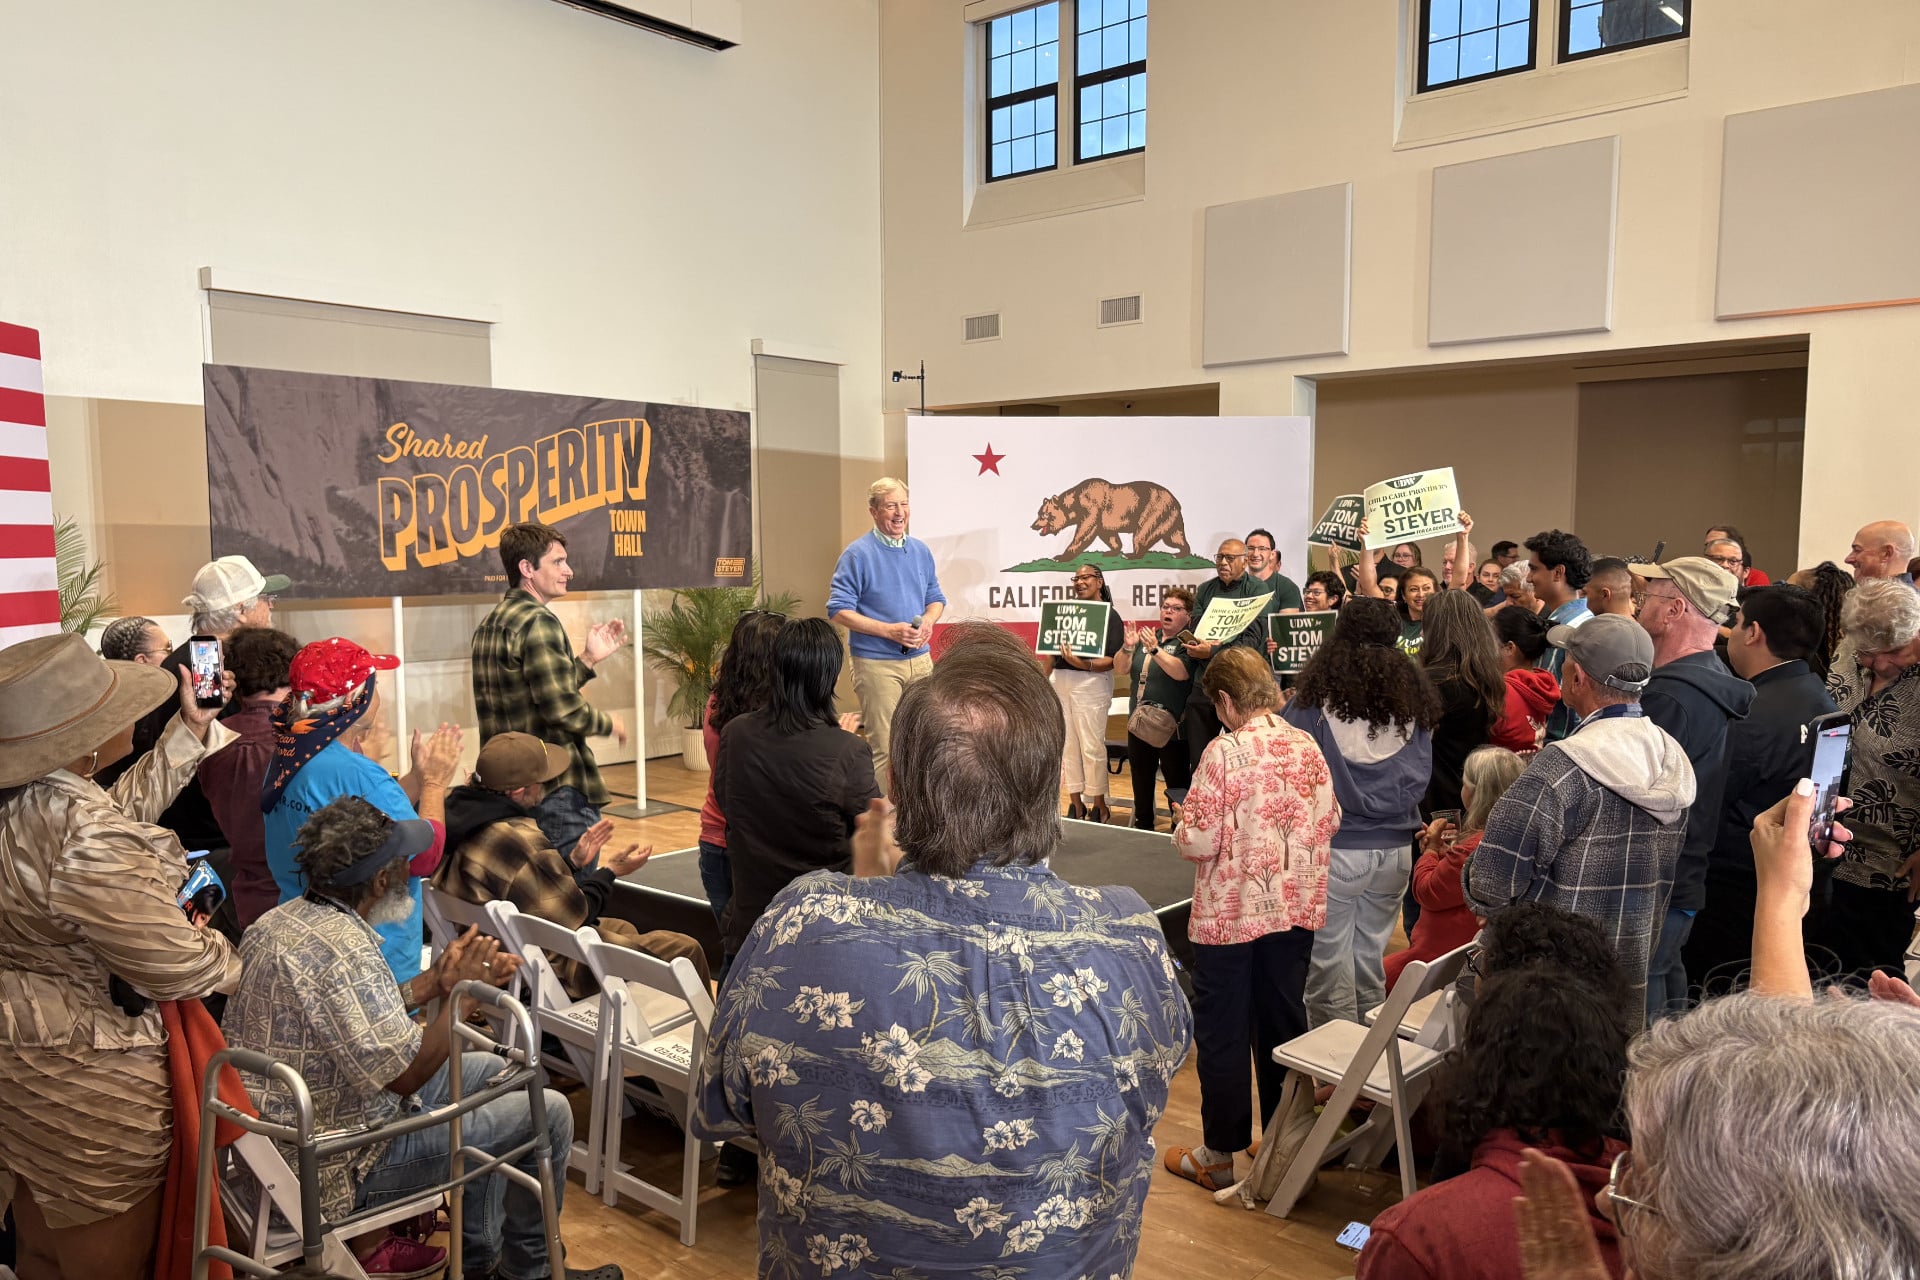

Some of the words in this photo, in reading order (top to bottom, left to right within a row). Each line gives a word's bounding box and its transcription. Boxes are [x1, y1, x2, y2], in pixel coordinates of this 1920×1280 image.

[377, 422, 488, 463] Shared
[1393, 477, 1415, 488] UDW
[378, 418, 651, 571] PROSPERITY
[1388, 491, 1407, 501] CARE
[1380, 497, 1423, 518] TOM
[609, 509, 647, 533] TOWN
[1331, 509, 1358, 526] TOM
[1383, 507, 1455, 534] STEYER
[614, 533, 643, 557] HALL
[1057, 605, 1079, 615] UDW
[1055, 616, 1087, 631] TOM
[1217, 613, 1245, 626] TOM
[1289, 618, 1314, 629] UDW
[1043, 629, 1097, 647] STEYER
[1289, 630, 1323, 646] TOM
[1278, 646, 1321, 662] STEY
